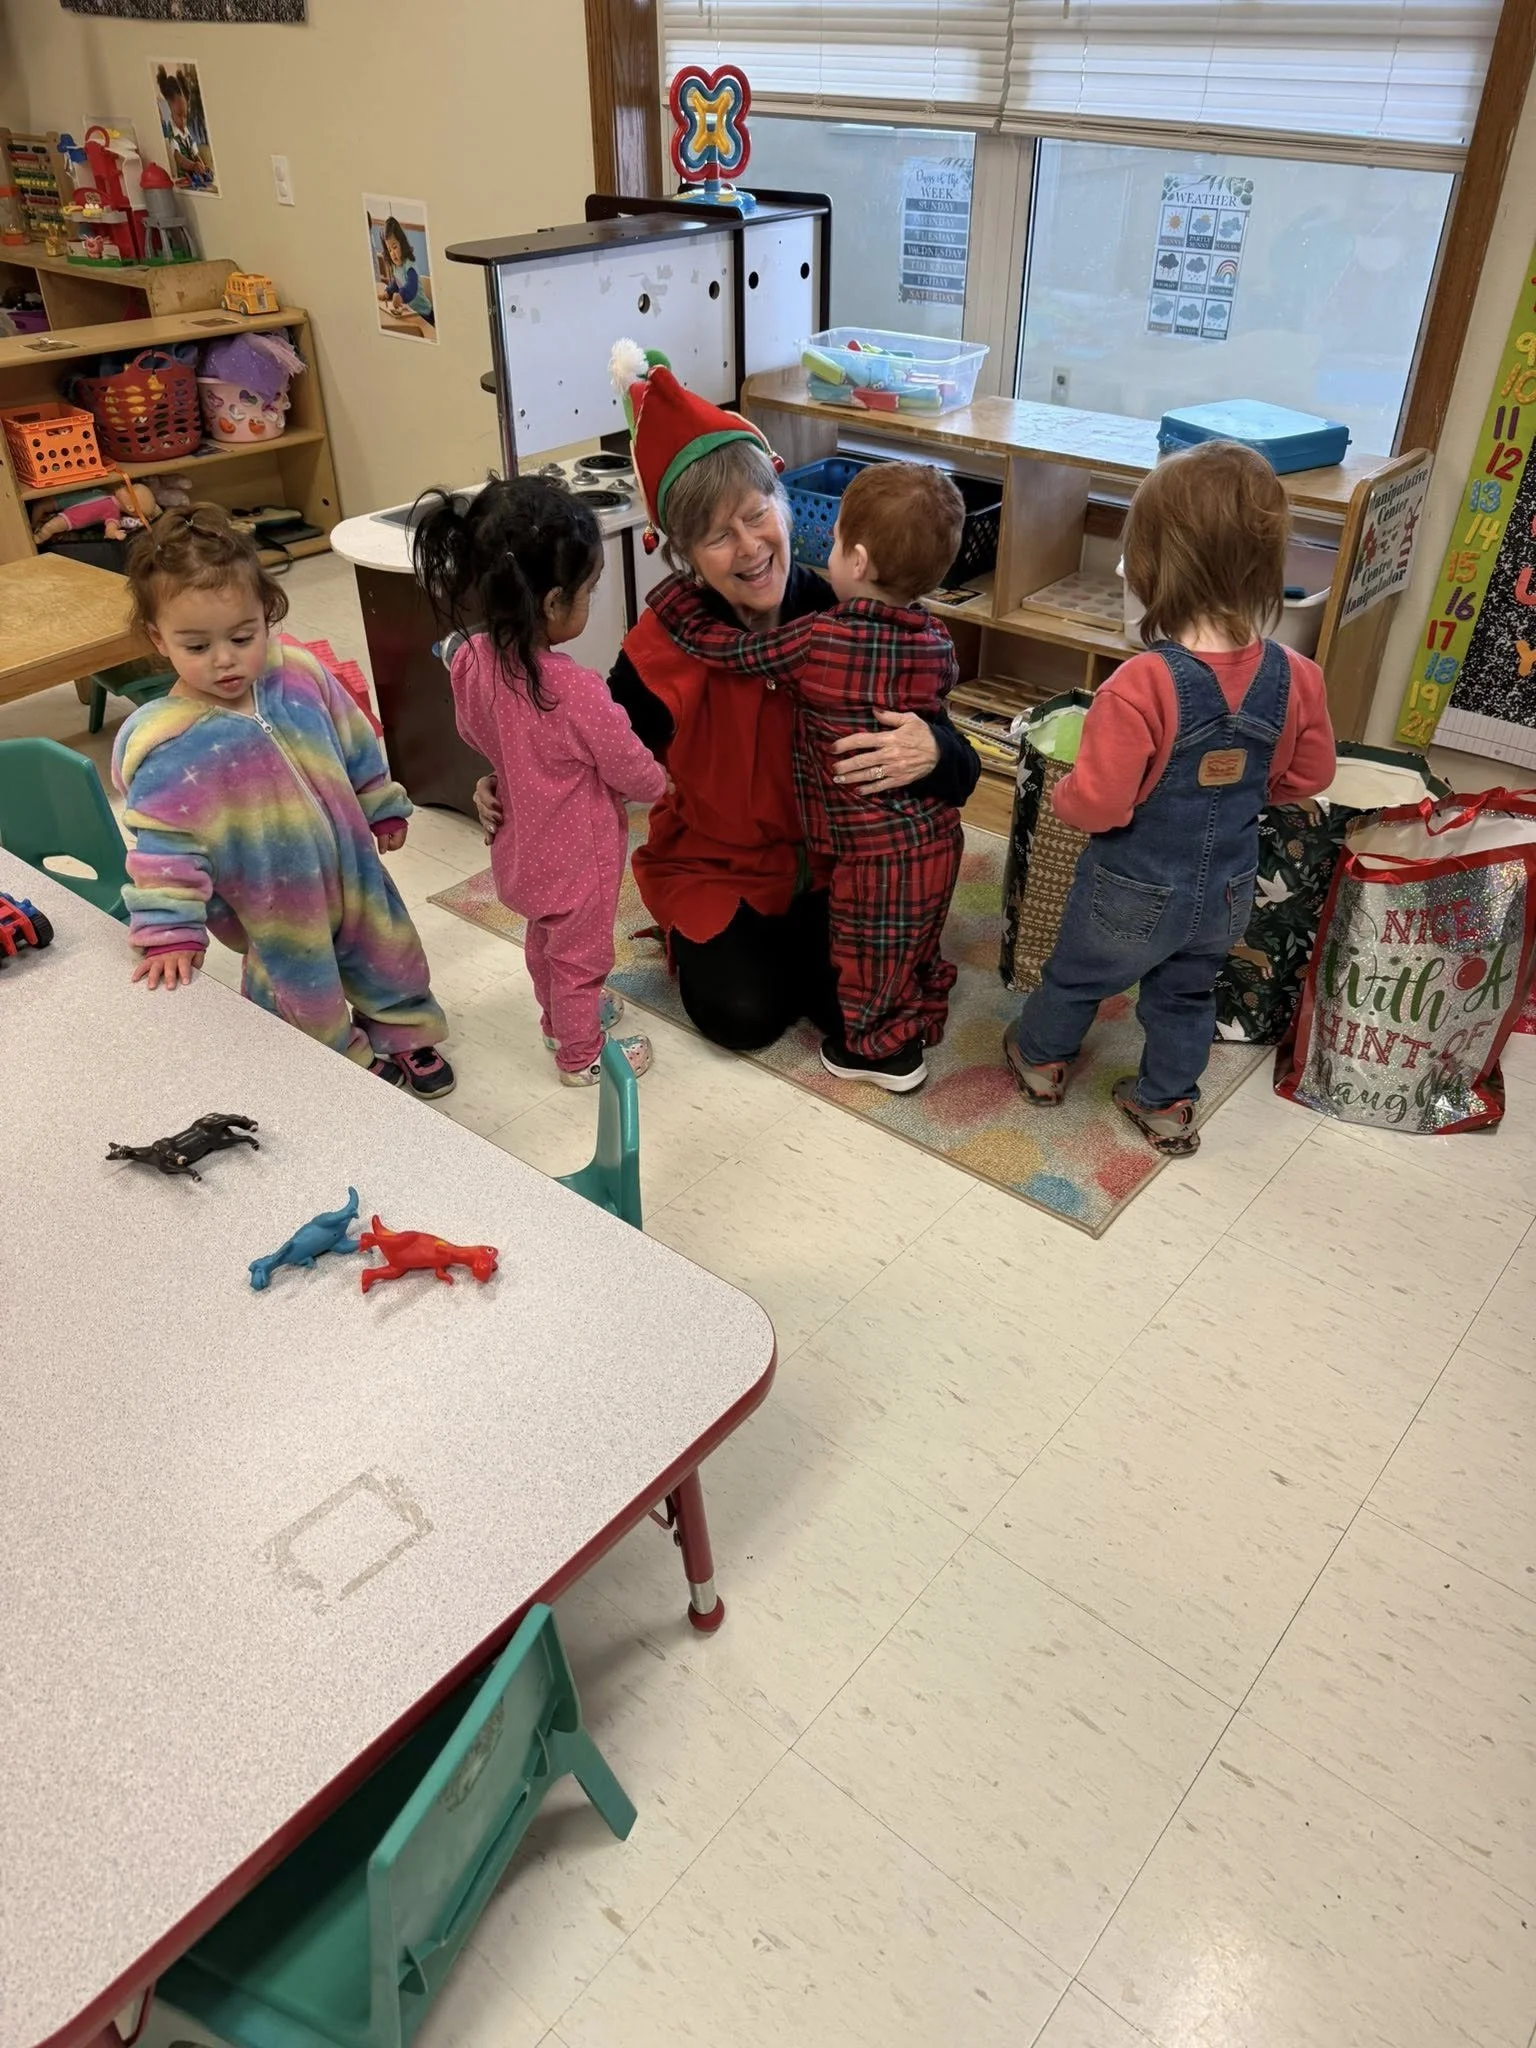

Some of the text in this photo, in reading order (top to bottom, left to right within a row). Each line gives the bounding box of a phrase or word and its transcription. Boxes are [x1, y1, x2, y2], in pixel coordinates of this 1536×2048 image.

[918, 200, 955, 212] SUNDAY
[921, 187, 953, 199] WEEK
[1175, 192, 1238, 207] WEATHER
[907, 245, 963, 259] WEDNESDAY
[915, 231, 957, 243] TUESDAY
[917, 275, 949, 288] FRIDAY
[1515, 332, 1536, 367] 9
[1501, 362, 1536, 405] 10
[1493, 405, 1520, 440] 11
[1486, 442, 1523, 481] 12
[1377, 498, 1409, 526] Center
[1468, 479, 1502, 514] 13
[1464, 513, 1501, 550] 14
[1361, 558, 1393, 586] Centro
[1446, 551, 1480, 583] 15
[1445, 586, 1477, 621] 16
[1426, 620, 1457, 651] 17
[1424, 651, 1460, 685] 18
[1409, 680, 1440, 712] 19
[1400, 711, 1435, 745] 20
[1380, 897, 1490, 945] NICE
[1323, 940, 1513, 1033] With A
[1317, 1009, 1496, 1070] HINT OF
